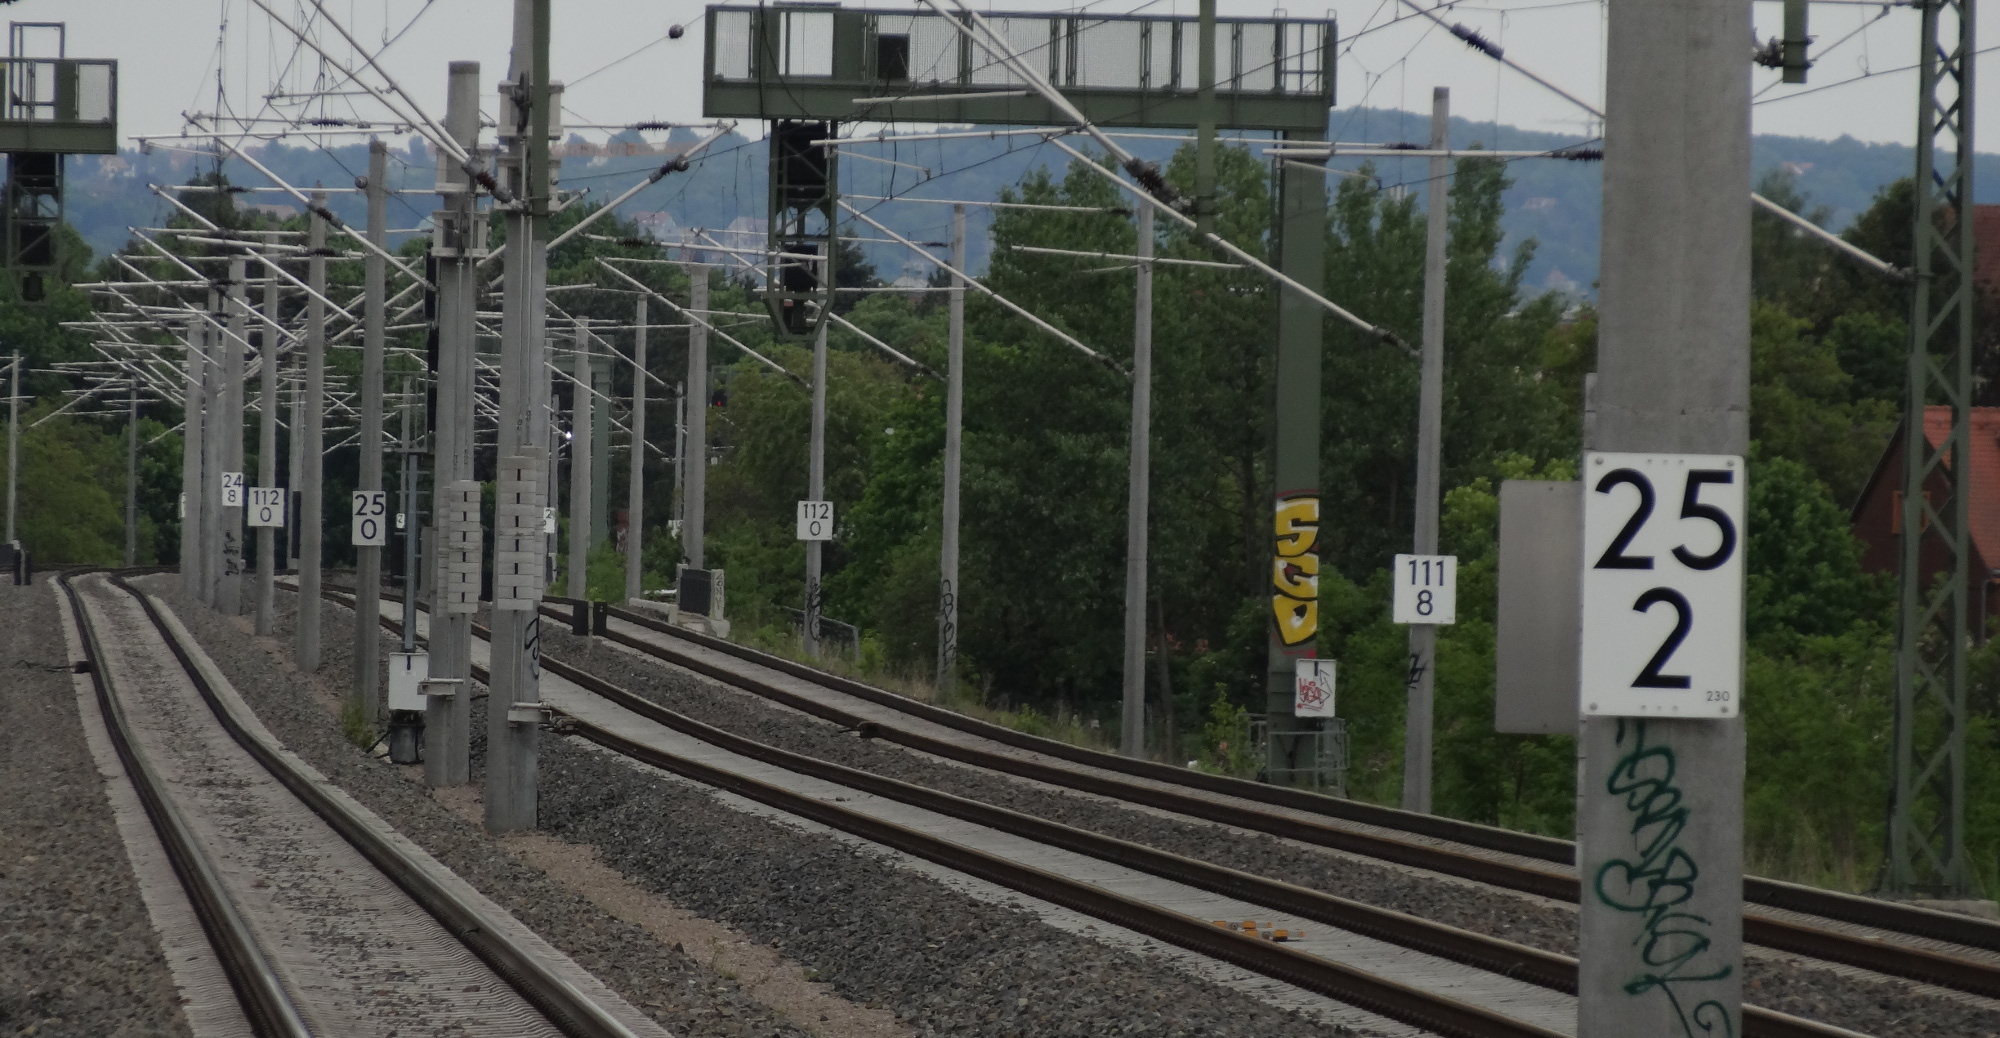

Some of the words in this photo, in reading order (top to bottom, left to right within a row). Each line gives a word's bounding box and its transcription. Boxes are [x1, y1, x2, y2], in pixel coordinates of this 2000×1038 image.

[223, 474, 243, 488] 24
[227, 489, 236, 502] 8
[253, 490, 279, 506] 112
[354, 493, 385, 516] 25
[803, 503, 829, 519] 112
[259, 507, 272, 522] 0
[1593, 467, 1736, 571] 25
[360, 518, 377, 540] 0
[809, 520, 822, 536] 0
[1408, 559, 1445, 586] 111
[1416, 589, 1434, 616] 8
[1630, 586, 1693, 690] 2
[1706, 690, 1730, 702] 230
